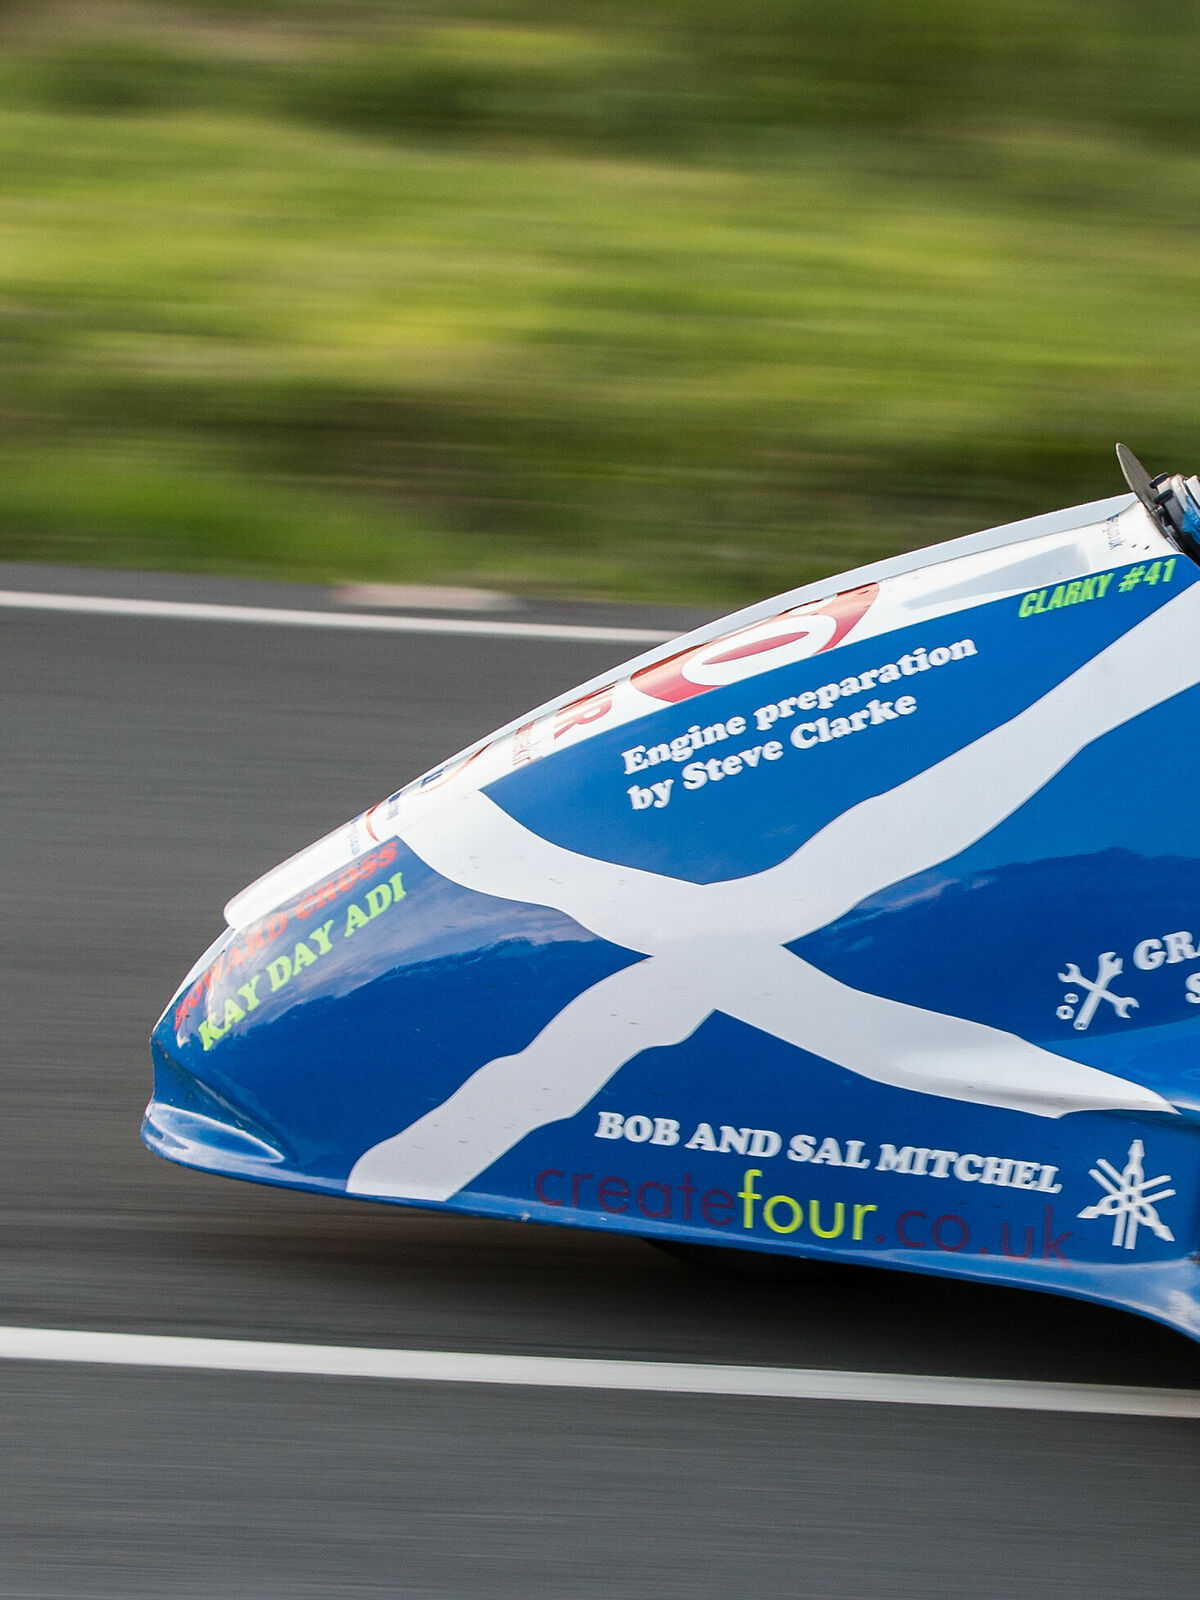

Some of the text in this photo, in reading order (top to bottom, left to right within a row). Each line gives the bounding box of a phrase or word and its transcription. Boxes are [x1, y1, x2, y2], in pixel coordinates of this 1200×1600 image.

[1018, 559, 1176, 618] CLARKY #41
[621, 716, 746, 775] Engine
[753, 638, 978, 731] preparation
[627, 695, 917, 810] by Steve Clarke
[296, 841, 398, 919] CROSS
[198, 872, 407, 1051] KAY DAY ADI
[595, 1112, 1062, 1195] BOB AND SAL MITCHEL
